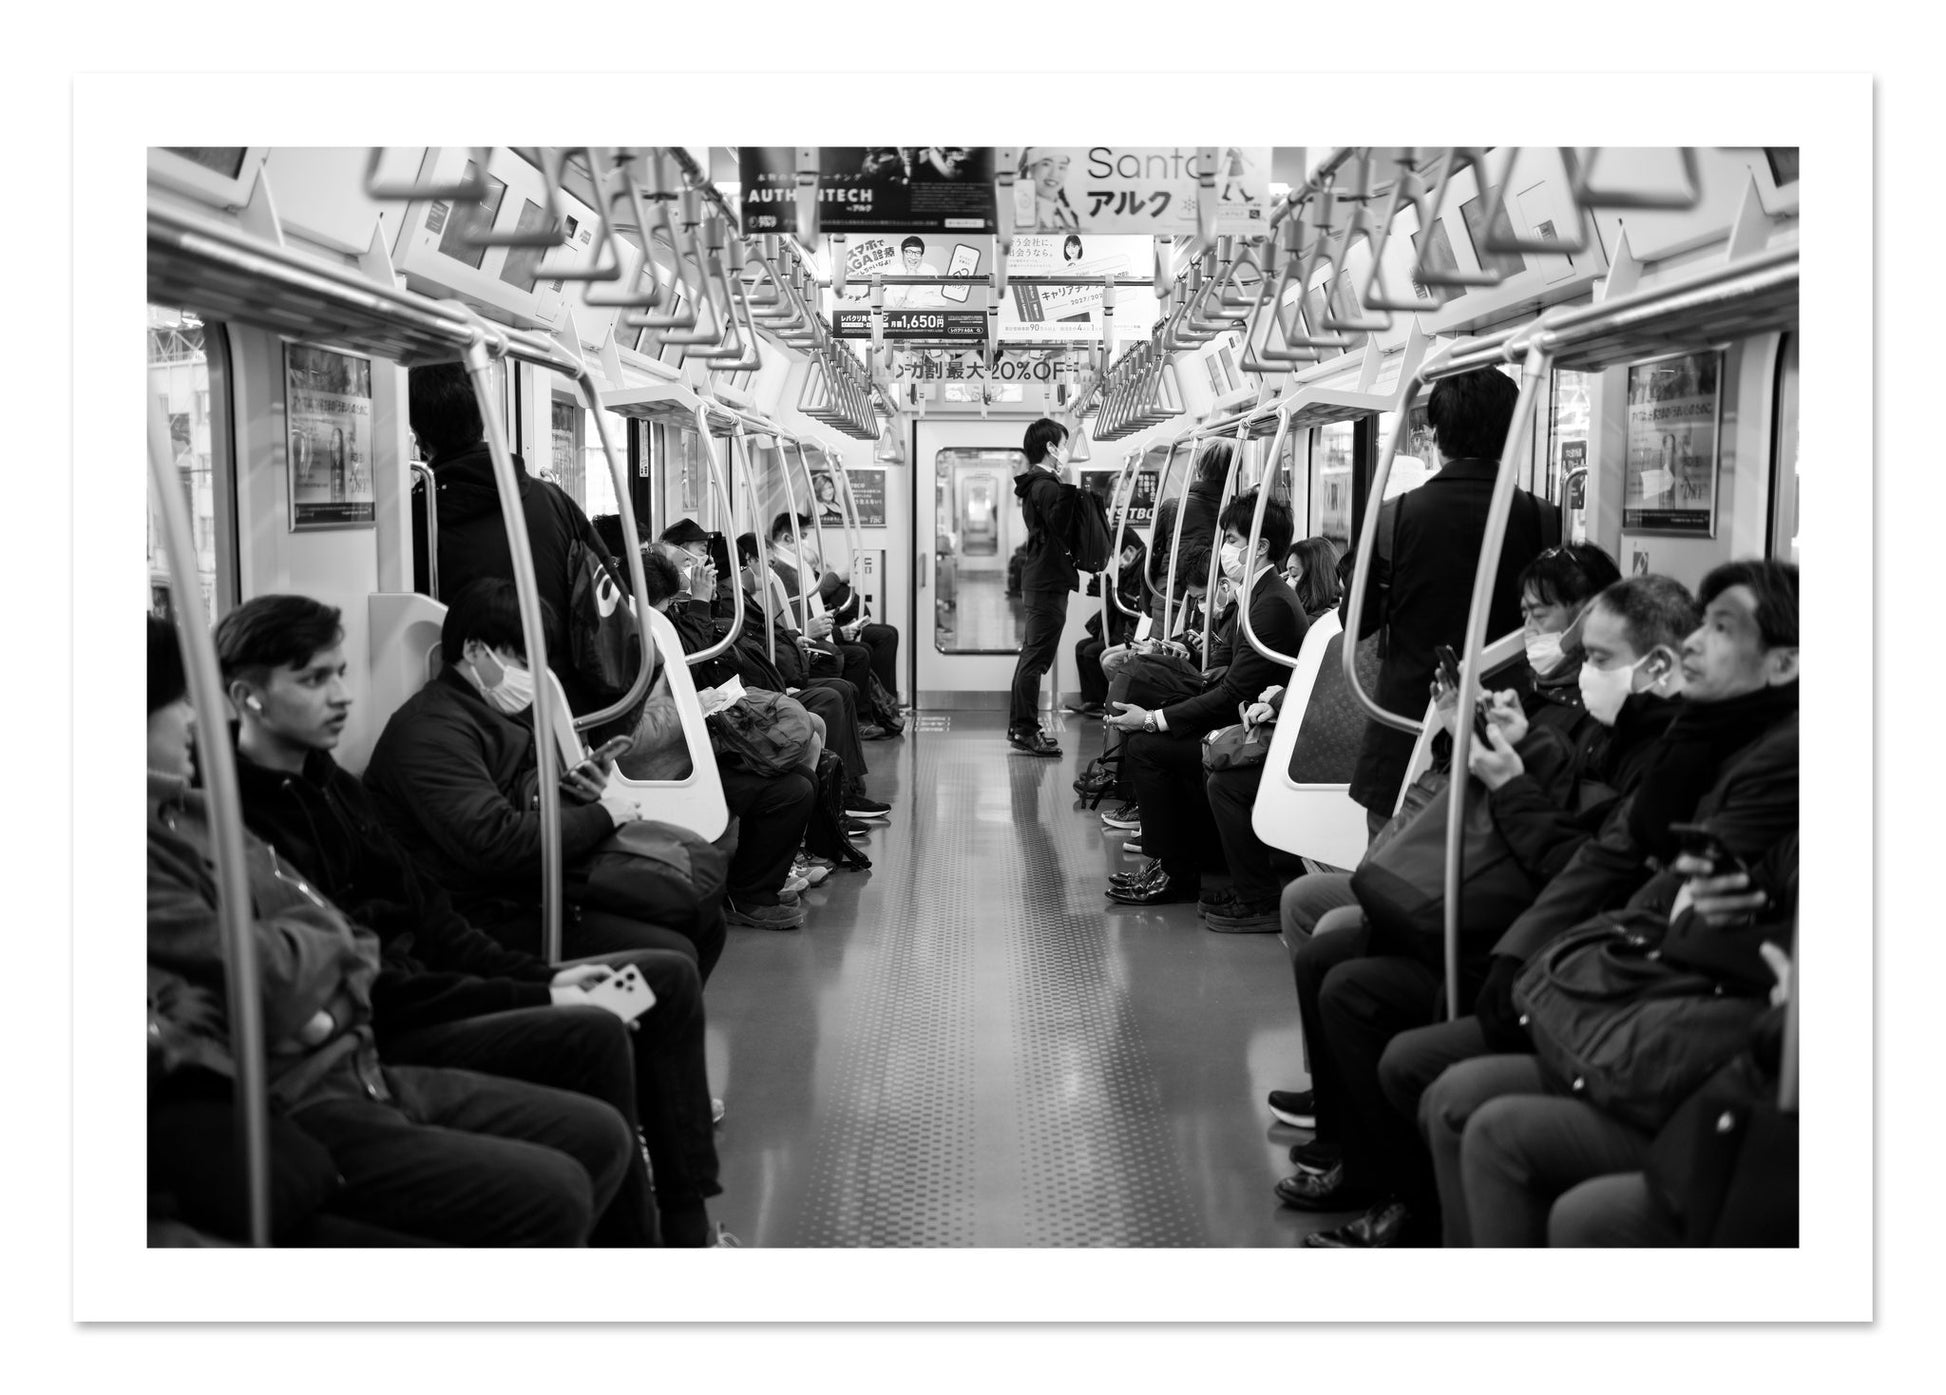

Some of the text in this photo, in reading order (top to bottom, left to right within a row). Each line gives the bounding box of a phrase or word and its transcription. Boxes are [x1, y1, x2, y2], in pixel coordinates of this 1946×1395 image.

[748, 188, 873, 203] AUTHTECH
[1087, 191, 1172, 218] アルク
